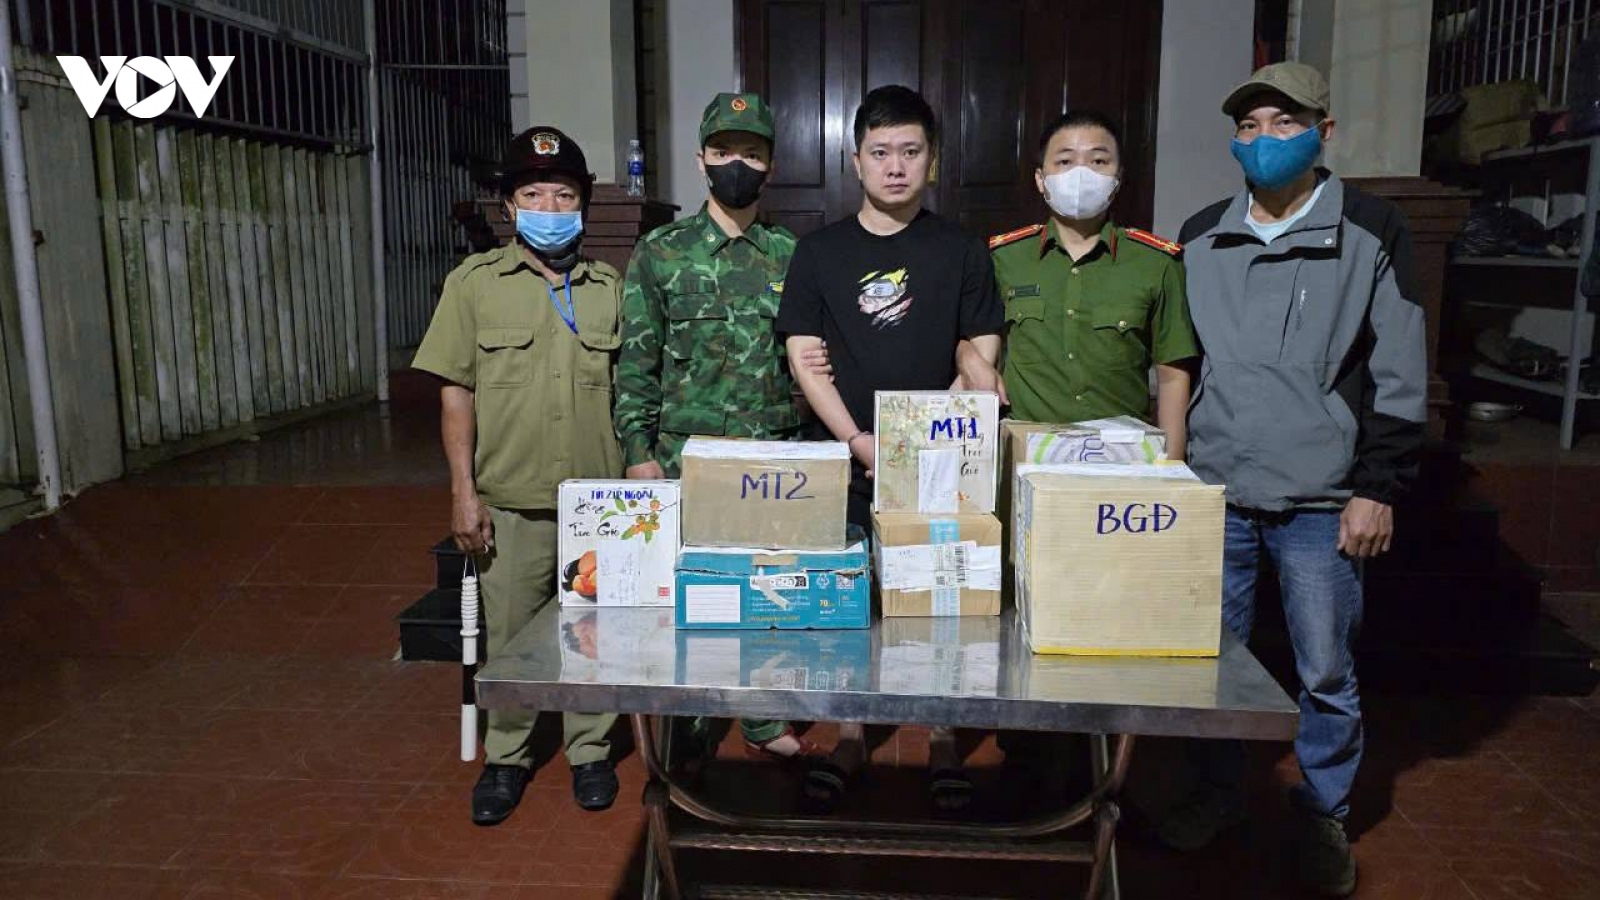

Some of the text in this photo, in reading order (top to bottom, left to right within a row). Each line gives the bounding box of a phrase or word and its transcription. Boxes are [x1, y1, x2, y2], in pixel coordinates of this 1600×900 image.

[929, 416, 978, 441] MT1
[741, 470, 816, 500] MT2
[1096, 503, 1178, 535] BGĐ
